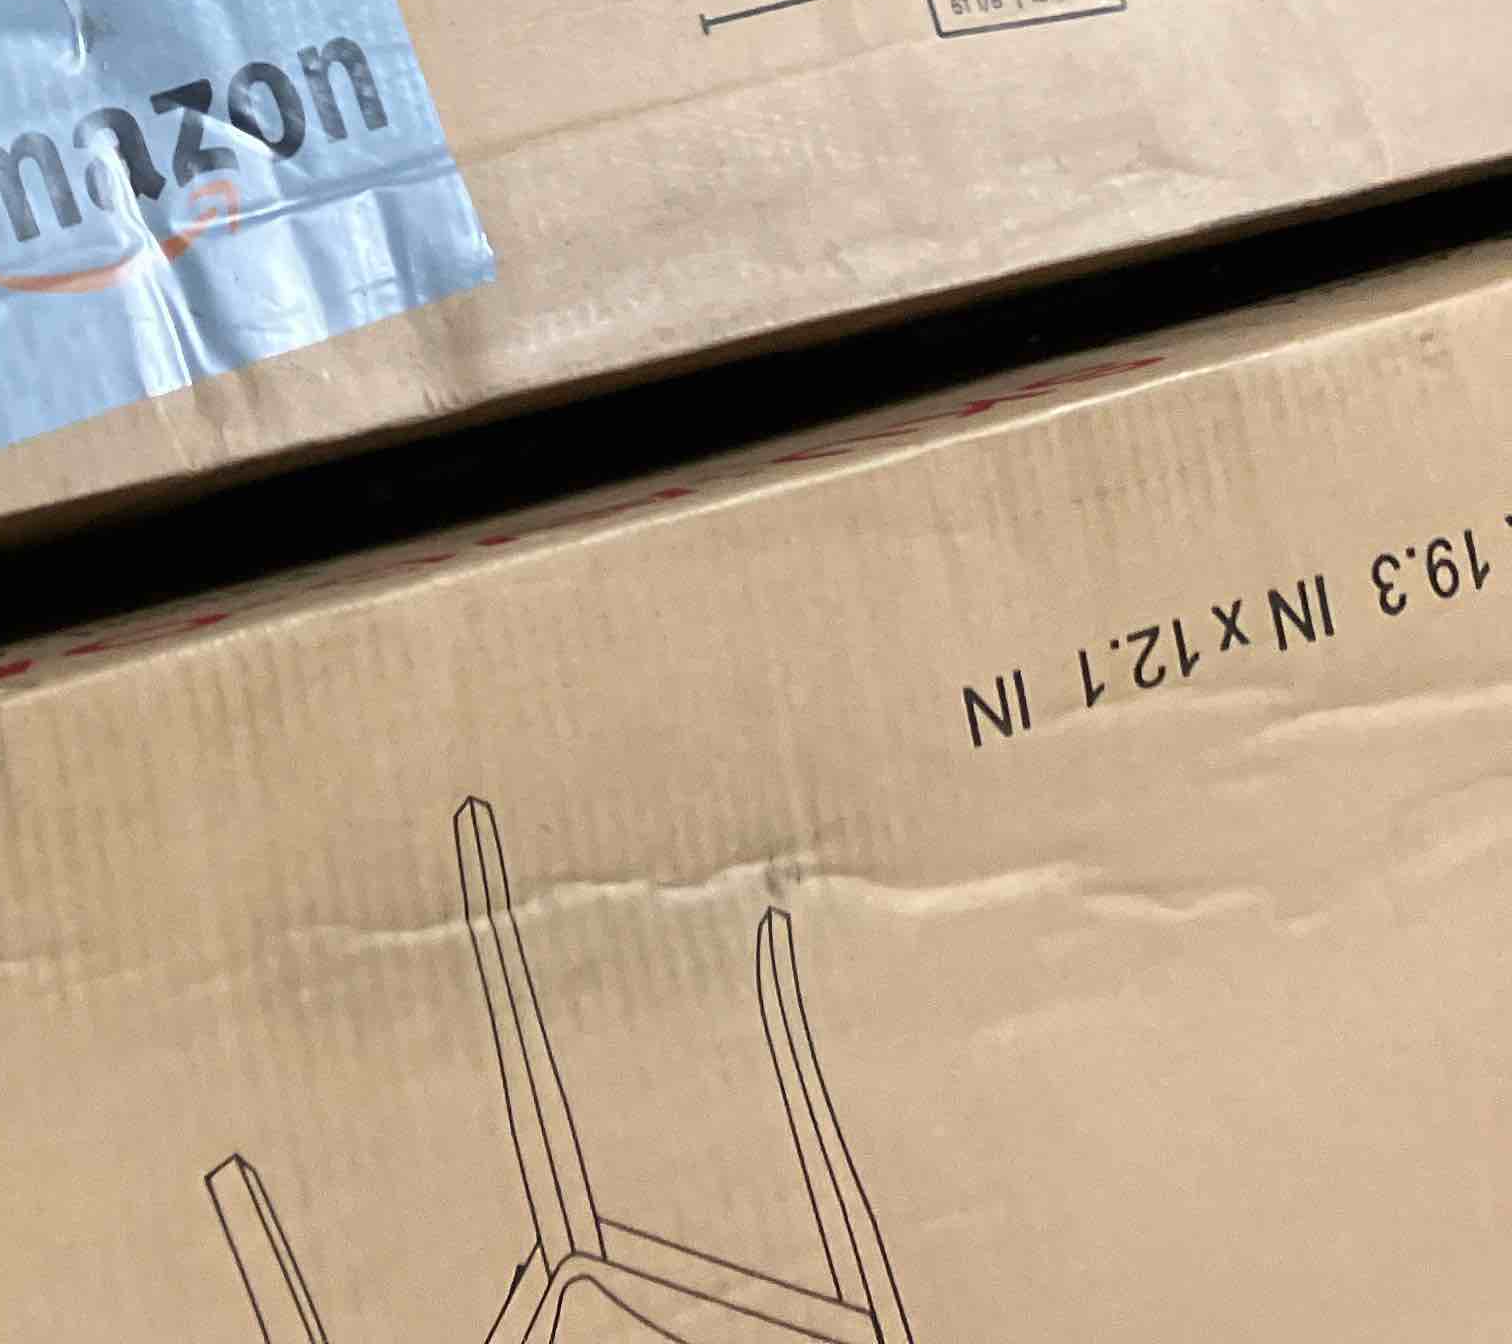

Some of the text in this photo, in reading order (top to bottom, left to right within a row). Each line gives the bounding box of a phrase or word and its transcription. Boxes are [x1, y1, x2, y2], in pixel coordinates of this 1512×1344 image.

[963, 529, 1489, 747] 19.3 IN x 12.1 IN
